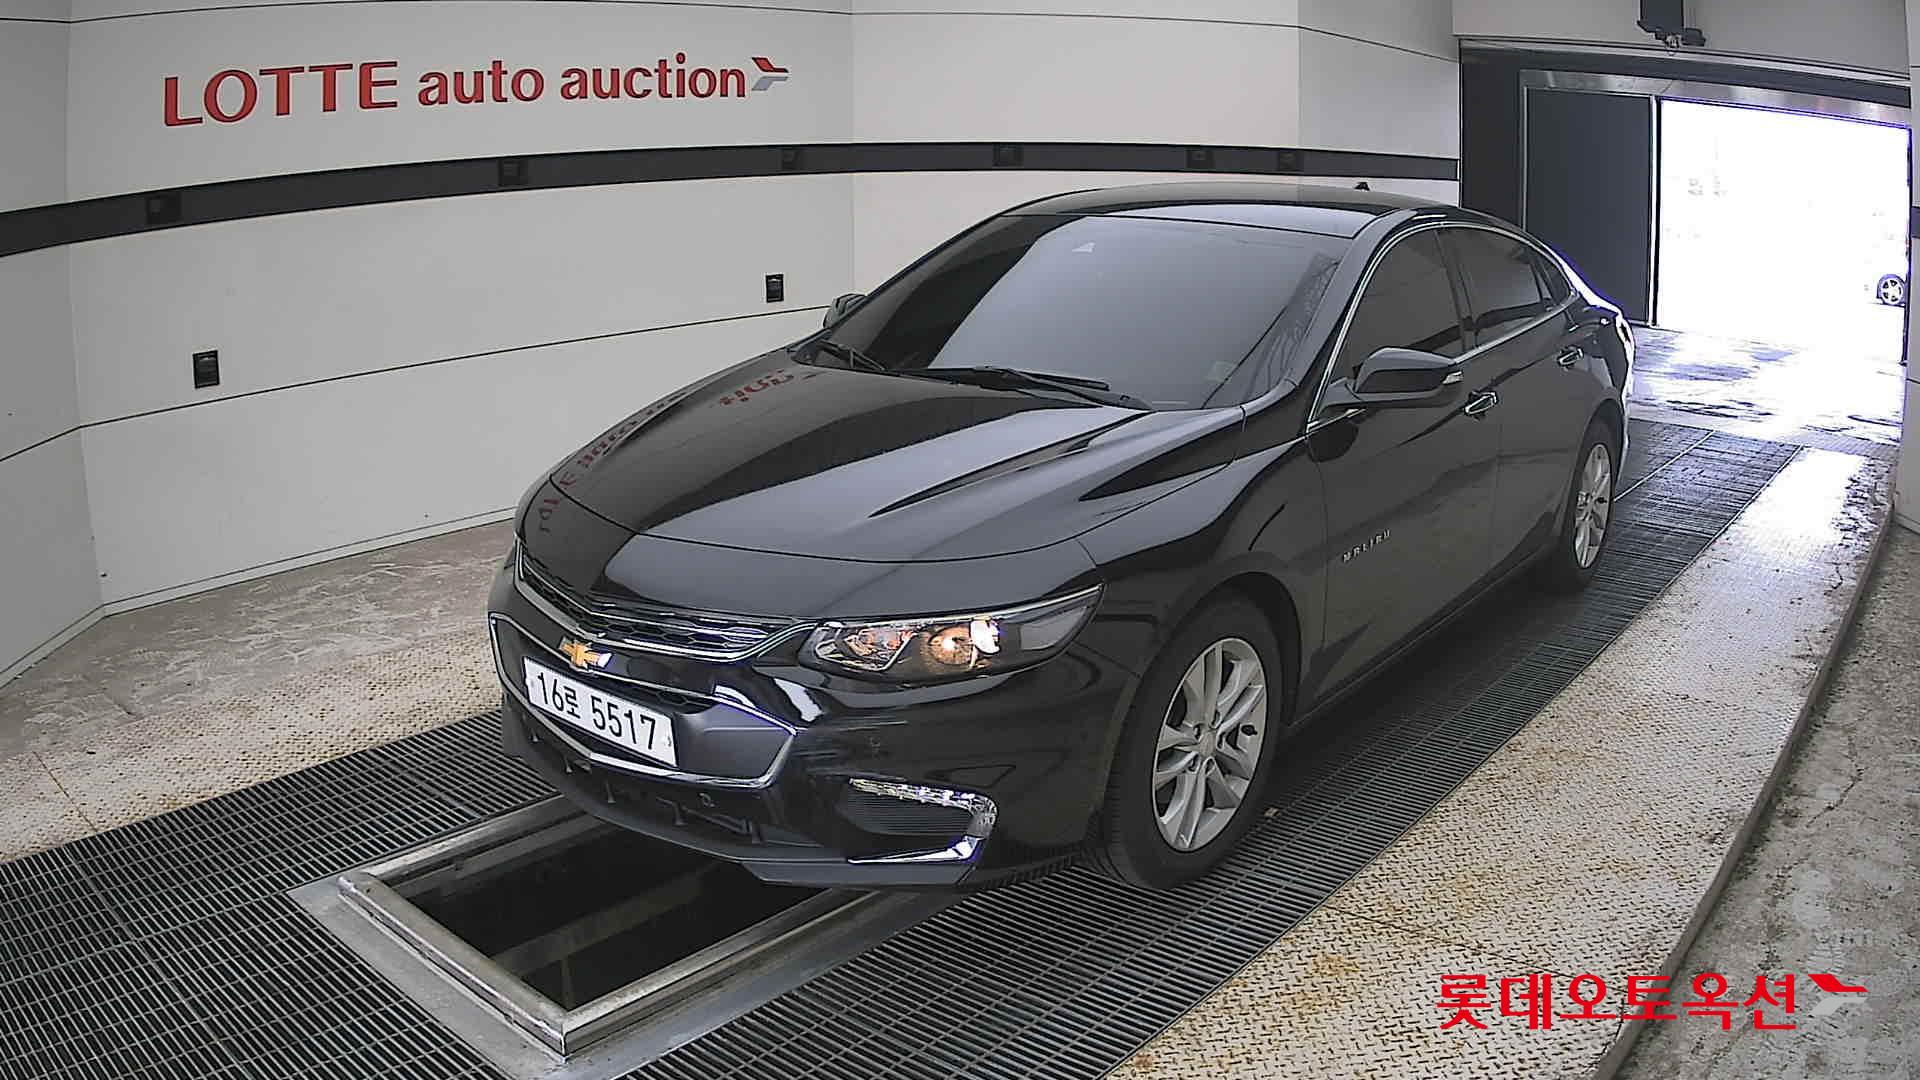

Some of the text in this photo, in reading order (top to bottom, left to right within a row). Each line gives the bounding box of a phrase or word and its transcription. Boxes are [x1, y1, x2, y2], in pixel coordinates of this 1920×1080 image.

[163, 51, 747, 128] LOTTE auto auction
[1342, 528, 1391, 563] MALIBU
[537, 672, 656, 750] 16로 5517
